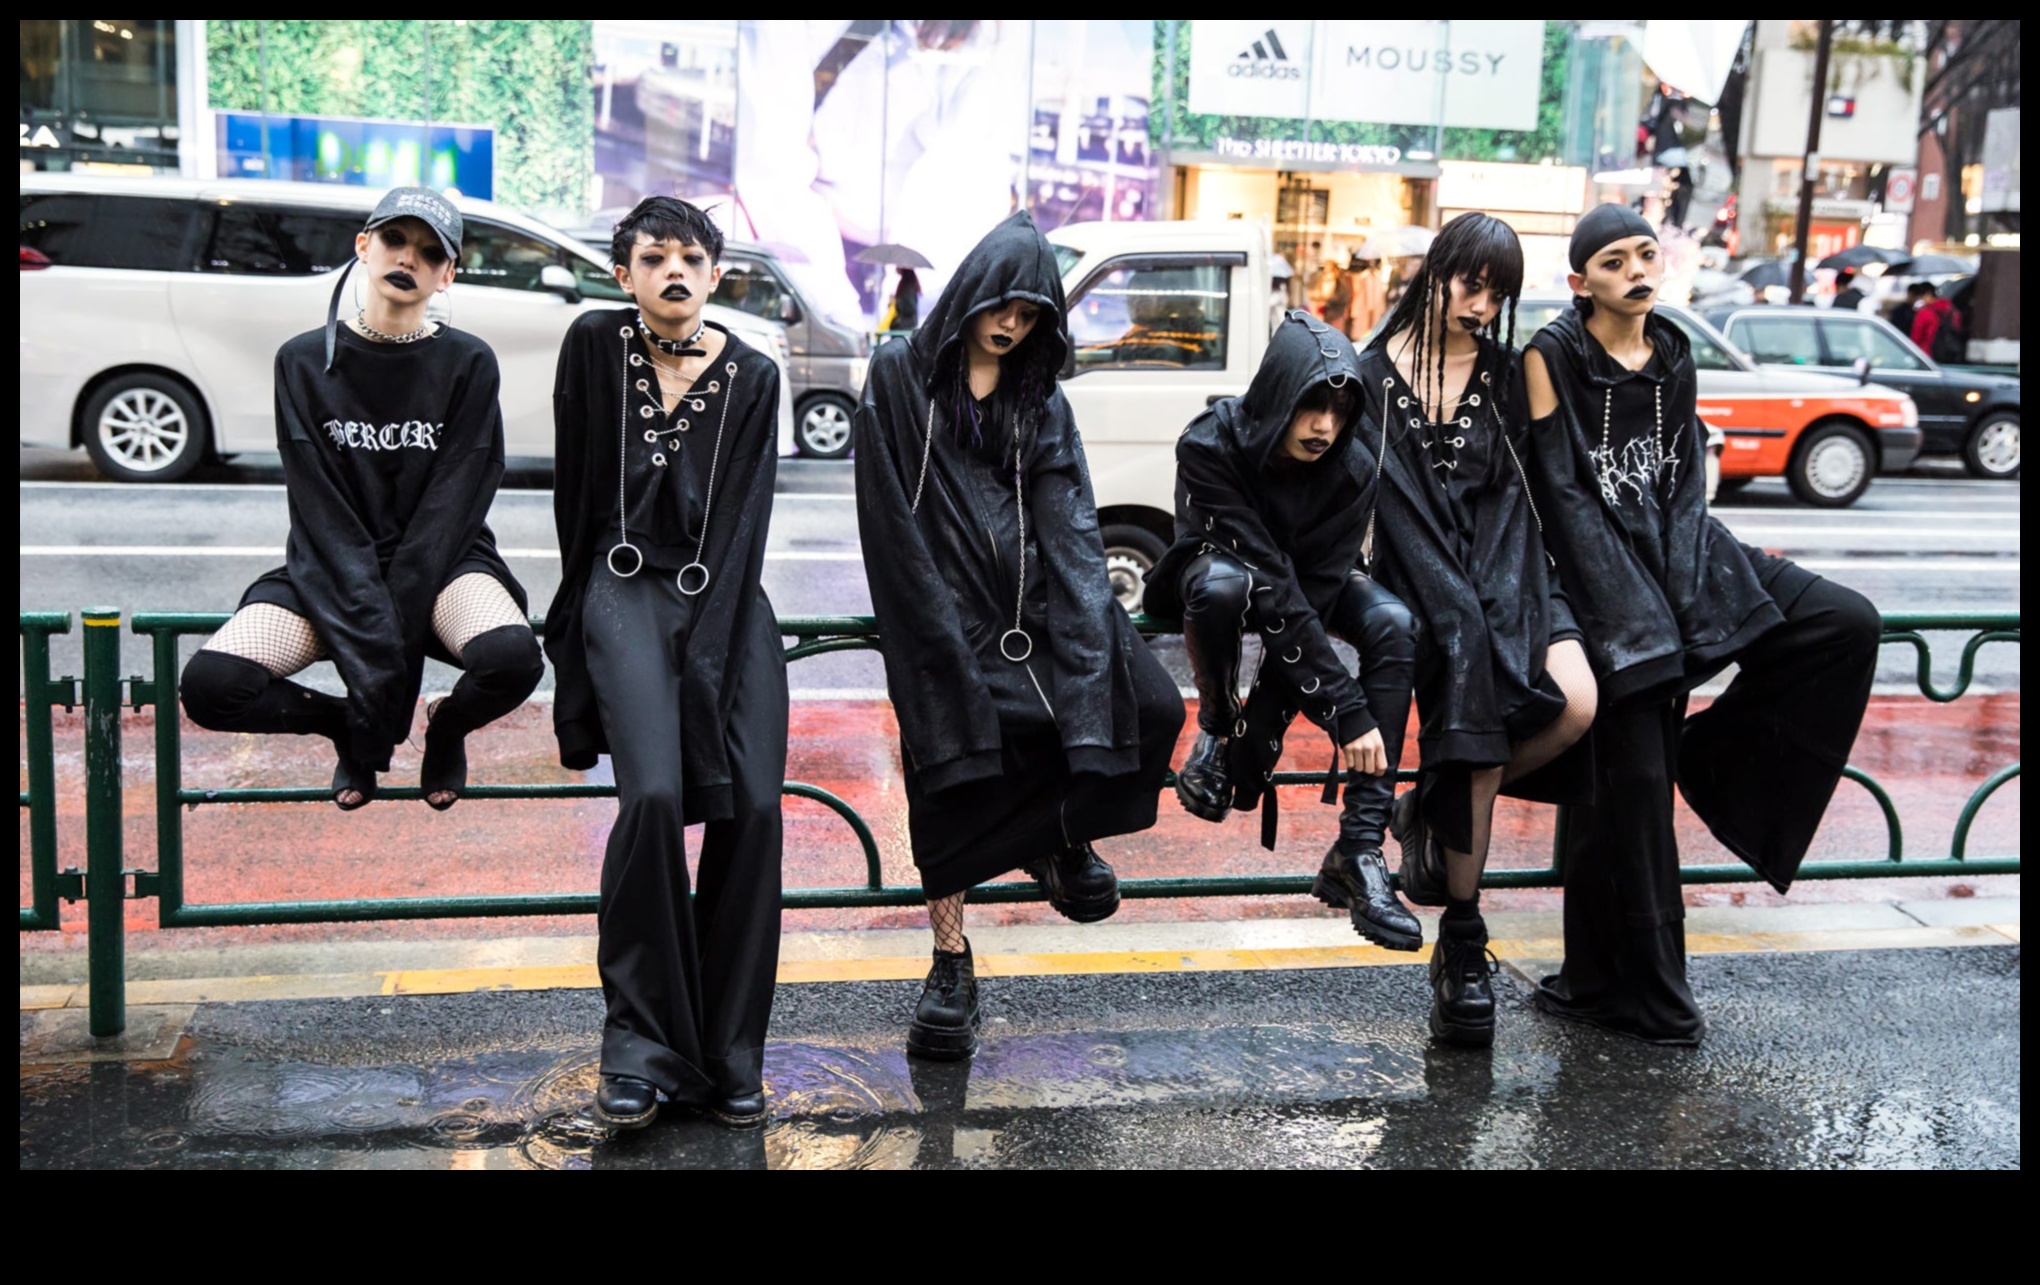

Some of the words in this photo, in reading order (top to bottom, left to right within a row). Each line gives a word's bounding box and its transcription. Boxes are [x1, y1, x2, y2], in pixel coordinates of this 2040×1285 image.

[1227, 61, 1301, 80] adidas
[1347, 46, 1505, 75] MOUSSY
[1339, 143, 1401, 165] TOKYO
